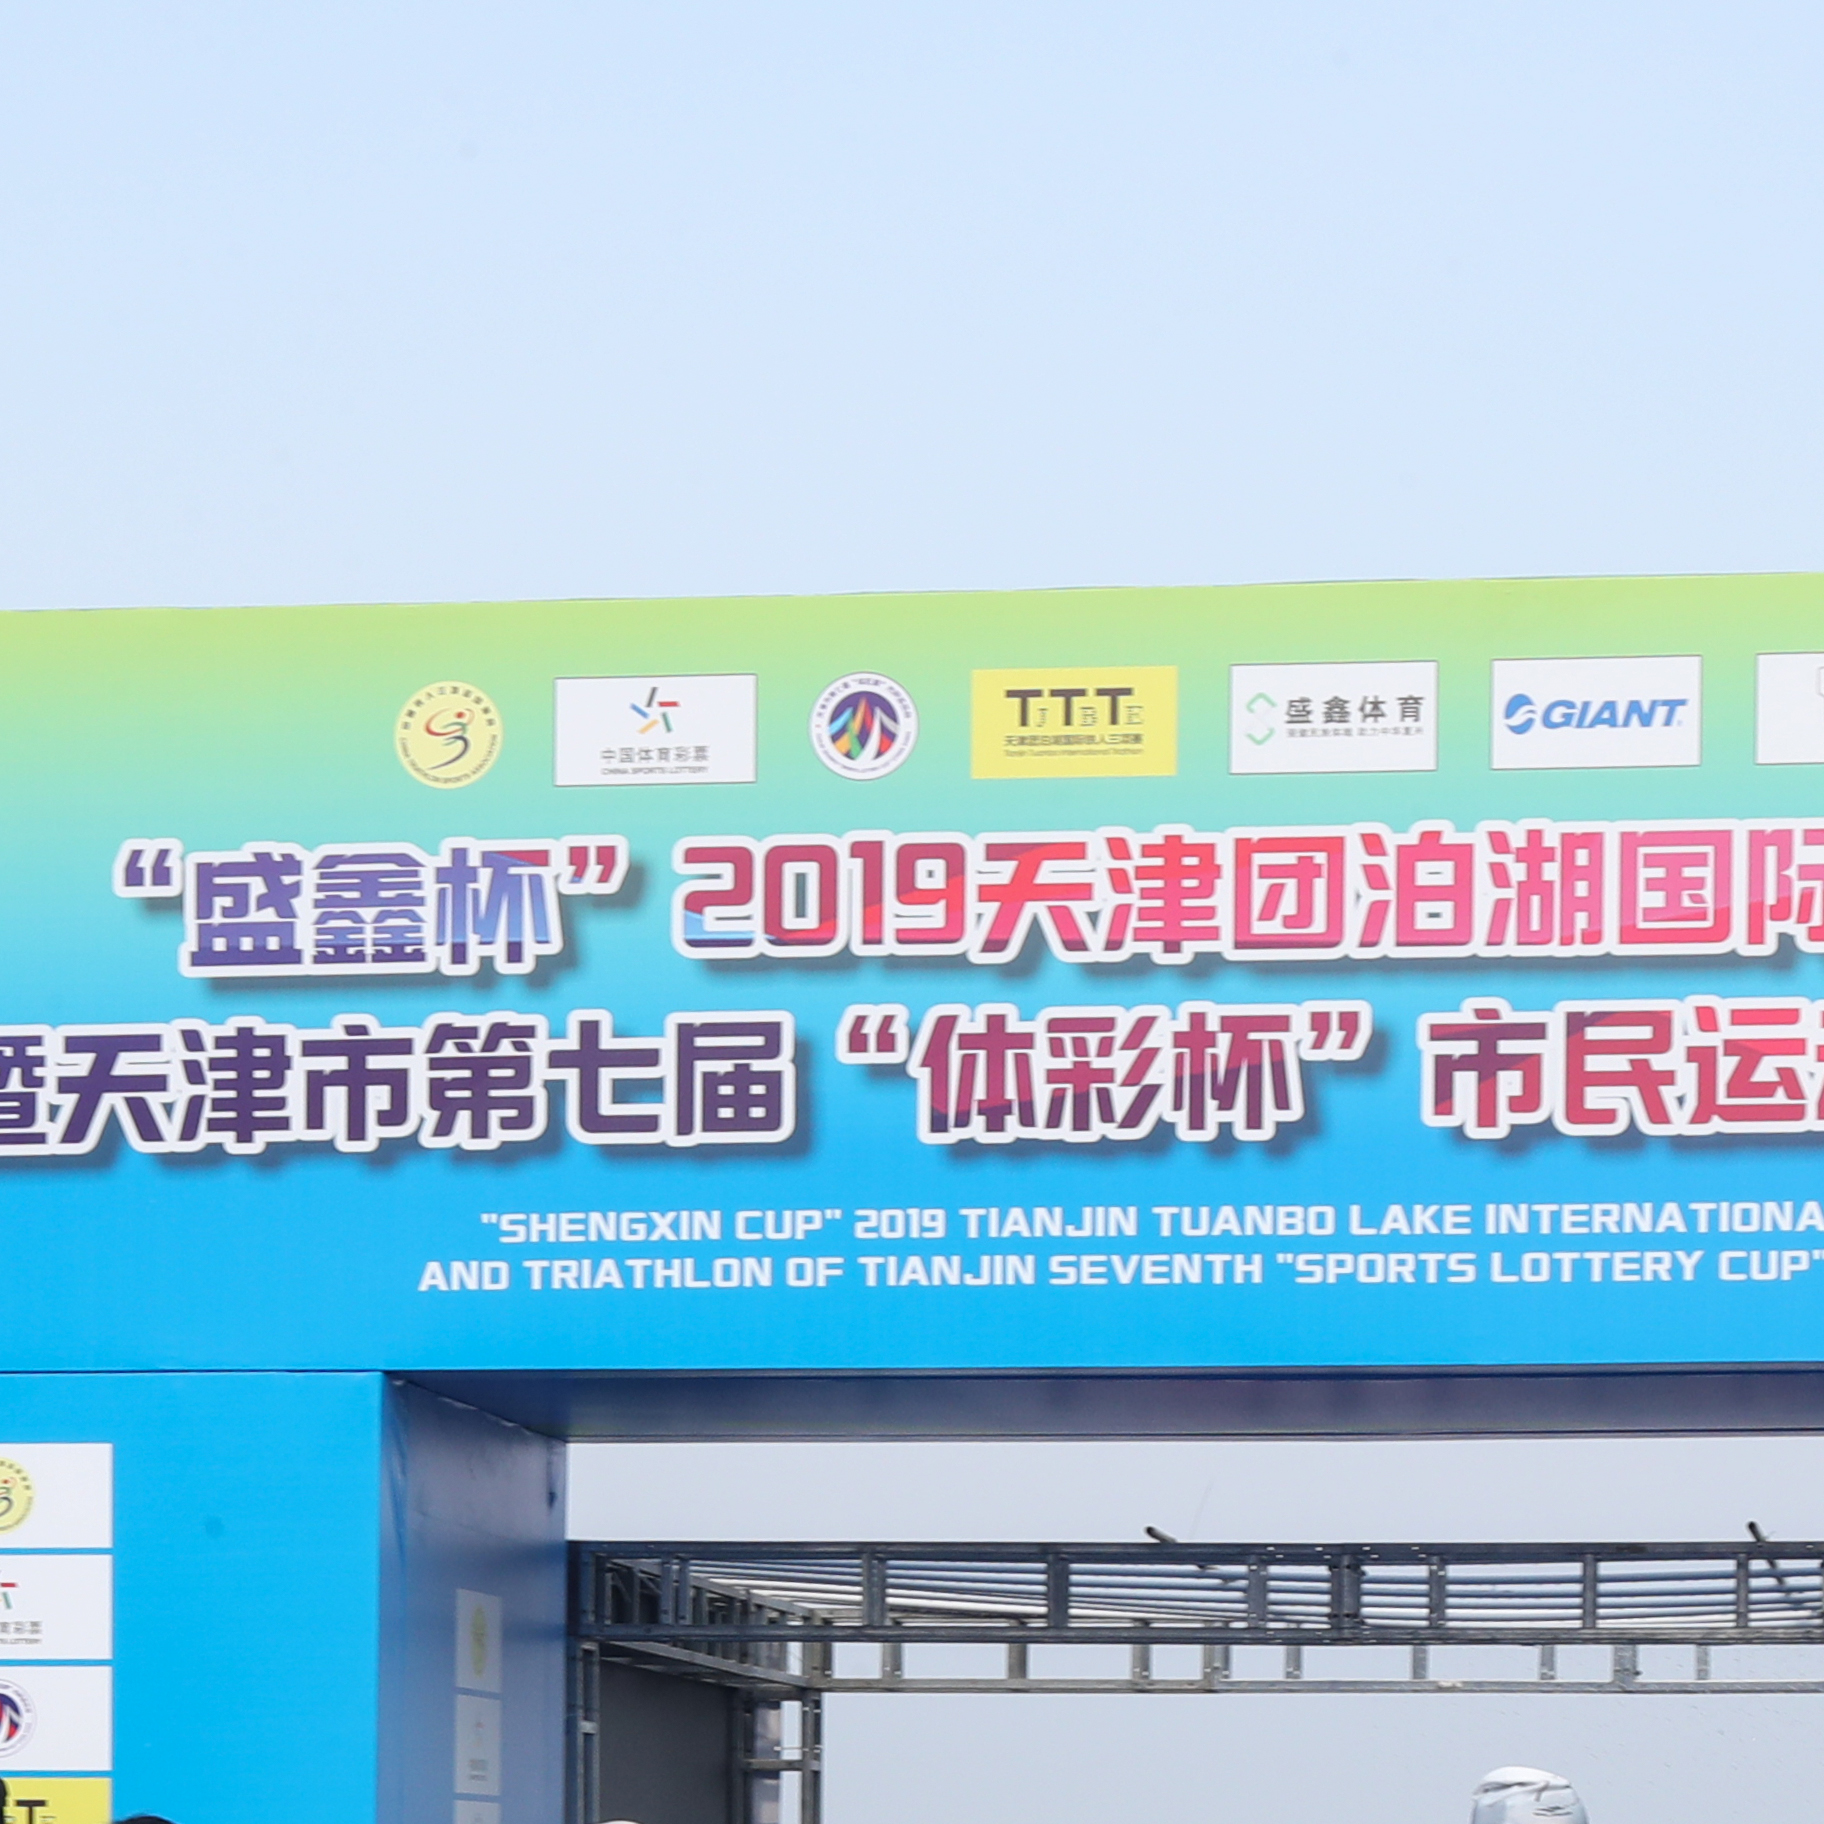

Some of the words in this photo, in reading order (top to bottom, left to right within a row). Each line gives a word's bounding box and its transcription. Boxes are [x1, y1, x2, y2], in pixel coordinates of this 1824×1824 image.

[1284, 693, 1425, 725] 盛鑫体育
[1540, 698, 1687, 729] GIANT
[600, 744, 710, 765] 中国体育彩票
[481, 1210, 721, 1244] "SHENGXIN
[736, 1209, 842, 1241] CUP"
[854, 1208, 946, 1239] 2019
[959, 1206, 1138, 1239] TIANJIN
[1152, 1206, 1336, 1238] TUANBO
[1348, 1204, 1473, 1237] LAKE
[418, 1260, 510, 1292] AND
[523, 1257, 774, 1290] TRIATHLON
[786, 1256, 845, 1288] OF
[857, 1254, 1036, 1287] TIANJIN
[1048, 1253, 1264, 1286] SEVENTH
[1276, 1251, 1477, 1284] "SPORTS
[1490, 1249, 1705, 1283] LOTTERY
